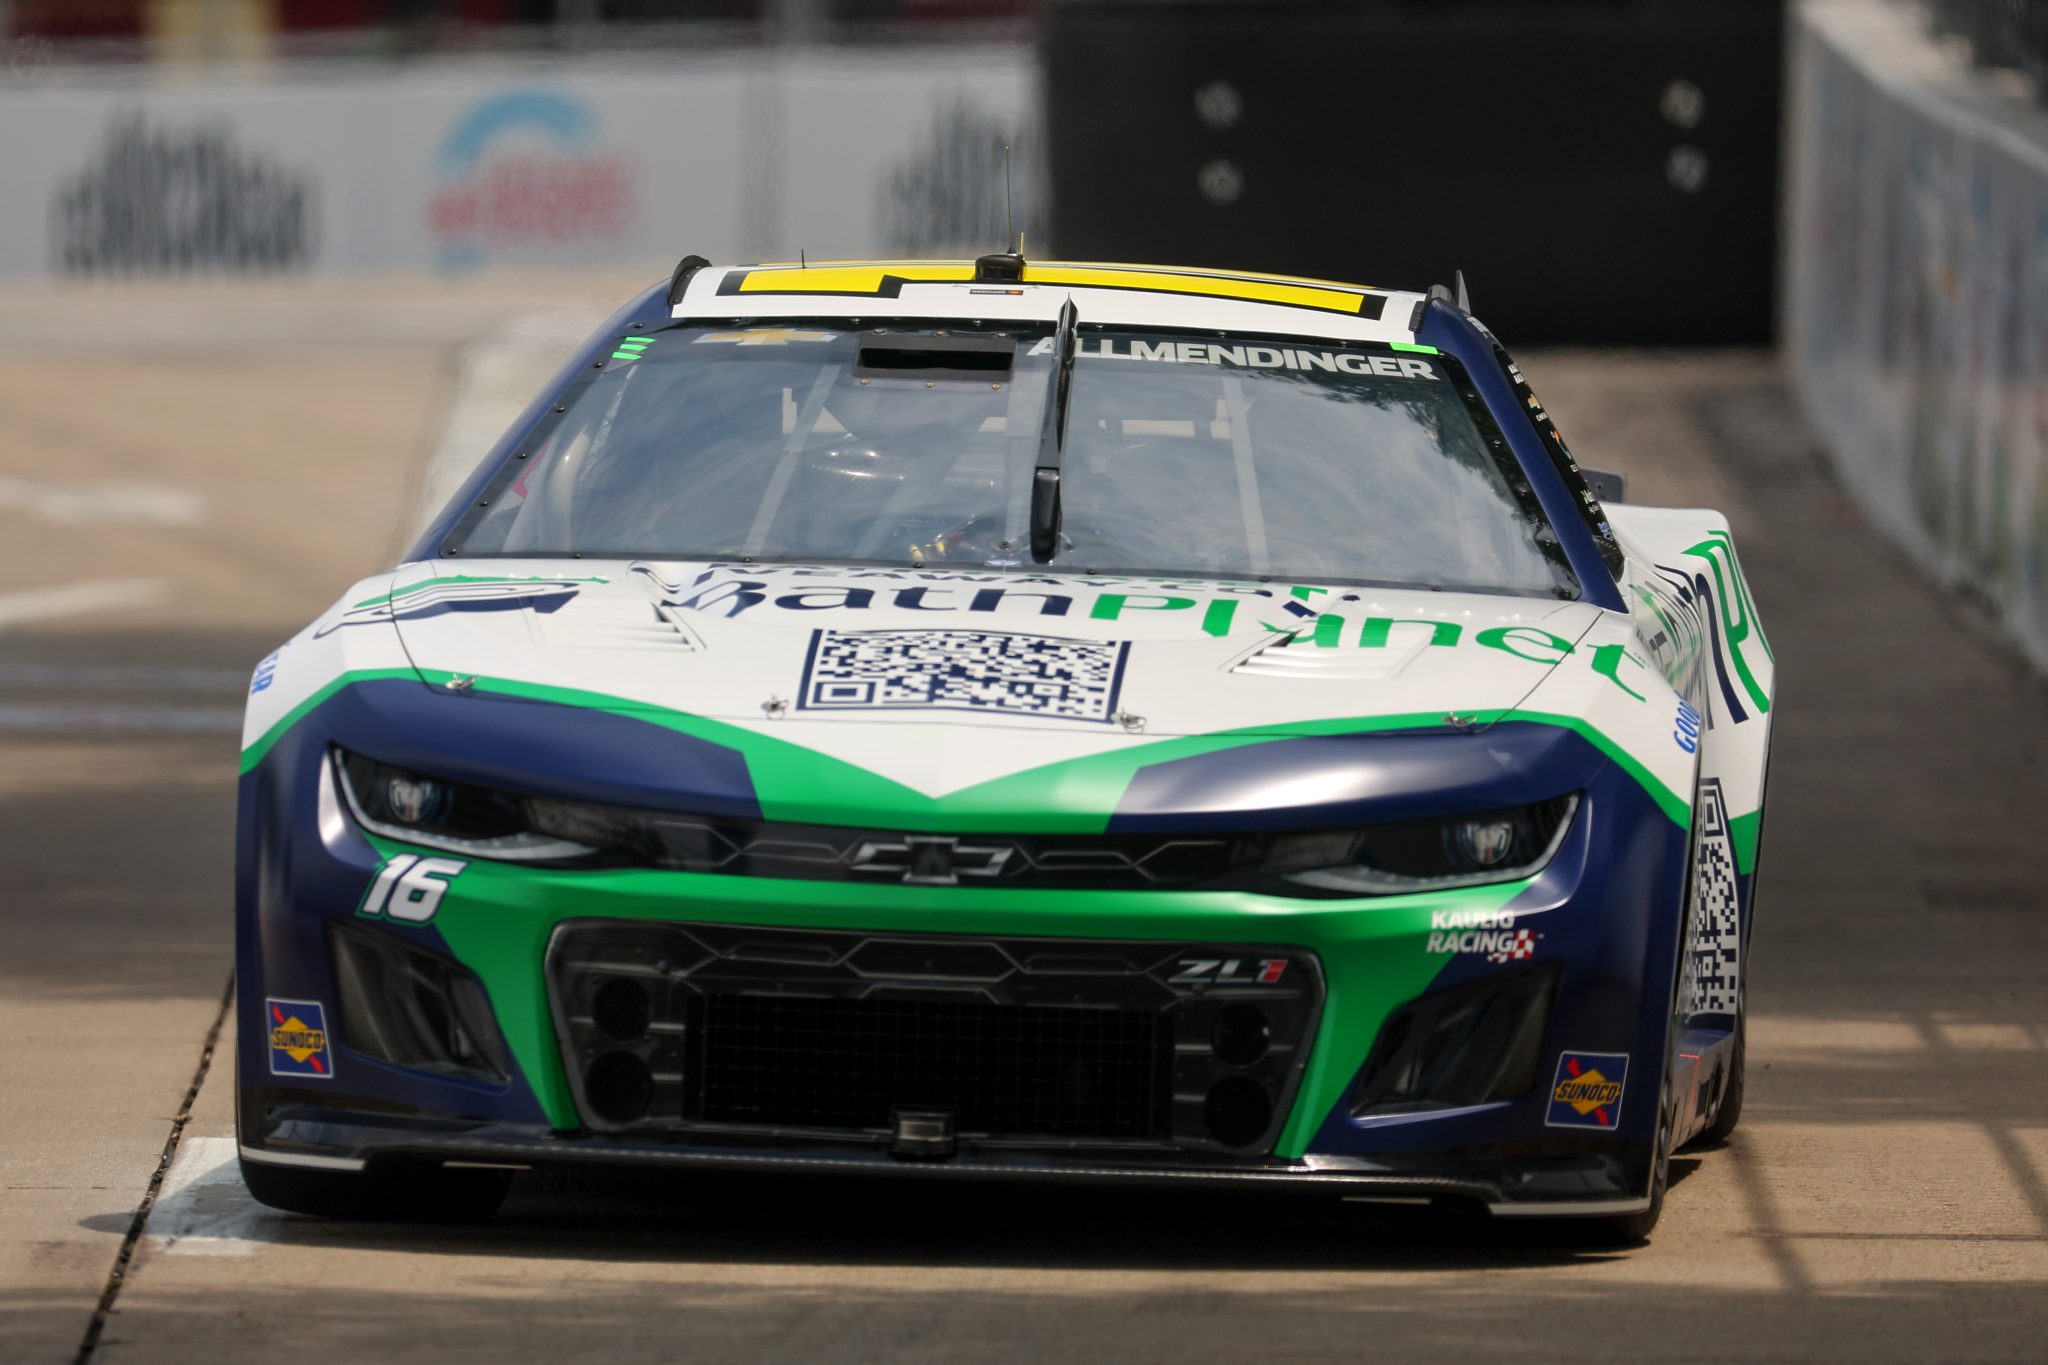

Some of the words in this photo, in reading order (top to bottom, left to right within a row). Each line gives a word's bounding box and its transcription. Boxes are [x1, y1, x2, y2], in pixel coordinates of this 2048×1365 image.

[1026, 335, 1440, 381] ALLMENDINGER
[359, 851, 469, 924] 16
[1426, 930, 1515, 954] RACING
[1166, 959, 1289, 983] ZL1
[272, 1029, 323, 1050] SUNOCO
[1557, 1082, 1619, 1102] SUNOCO
